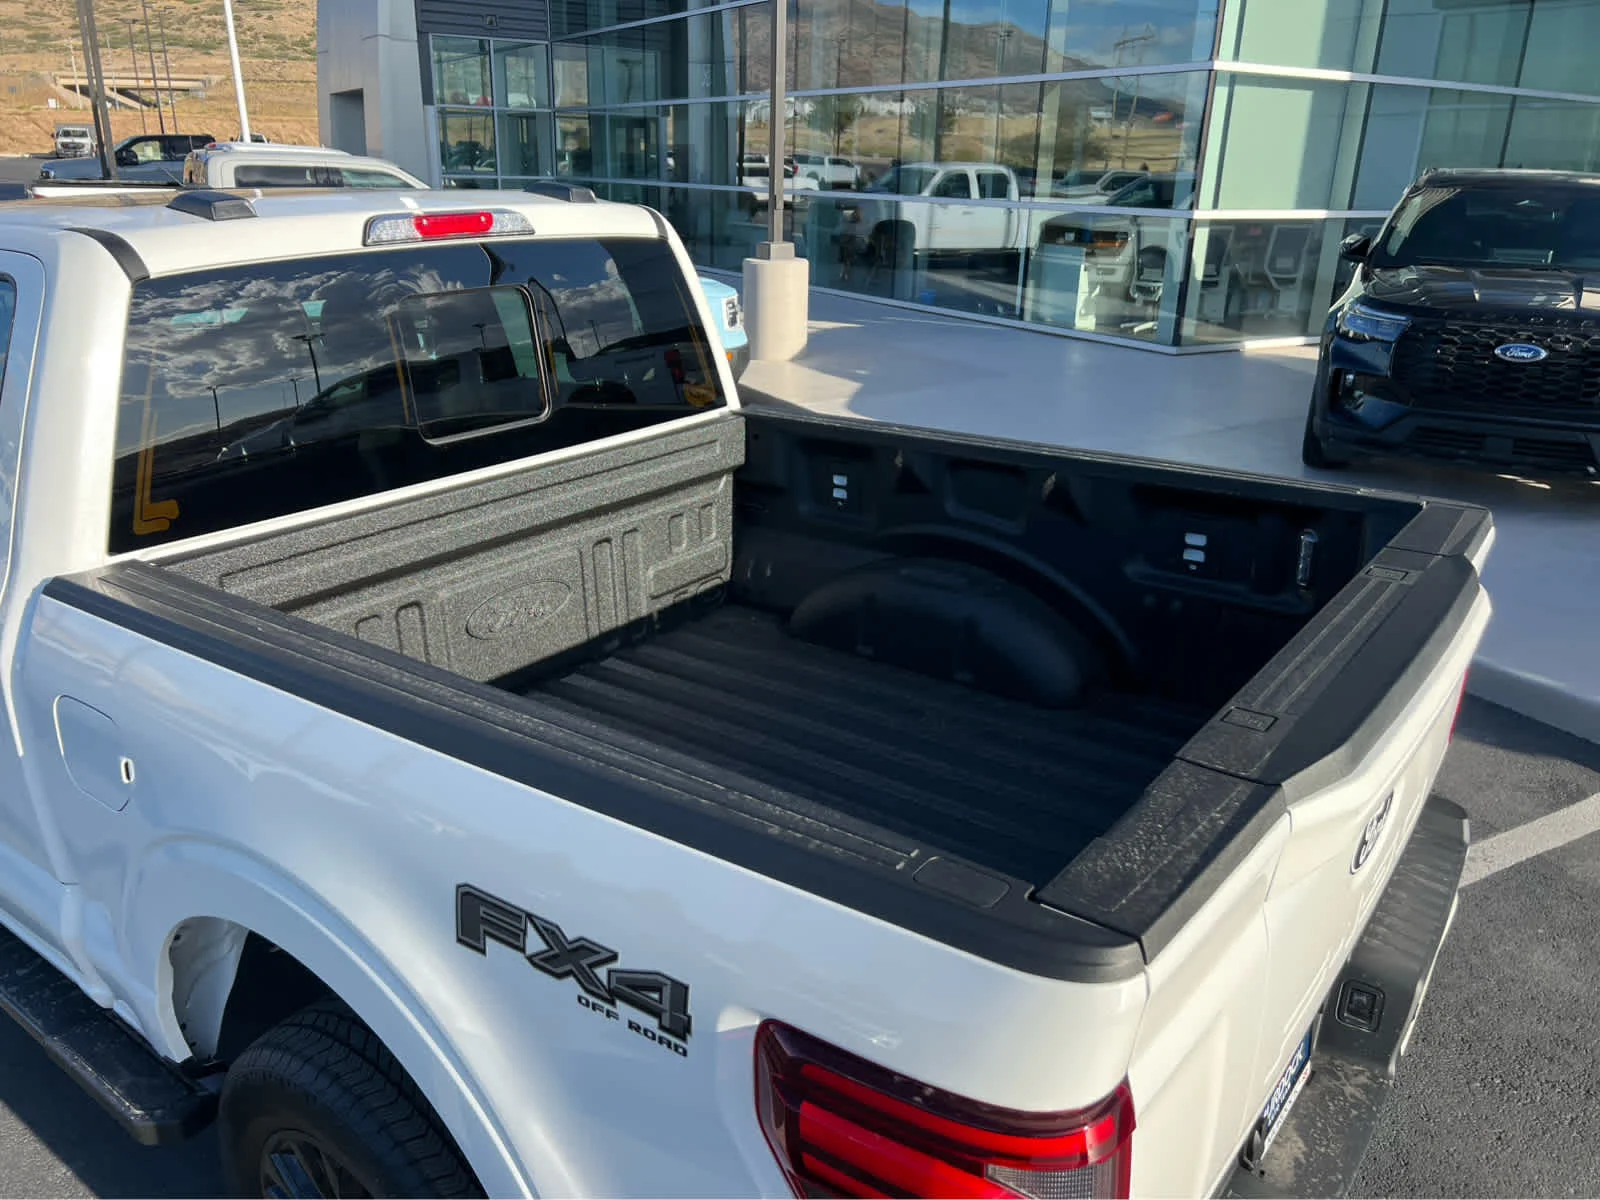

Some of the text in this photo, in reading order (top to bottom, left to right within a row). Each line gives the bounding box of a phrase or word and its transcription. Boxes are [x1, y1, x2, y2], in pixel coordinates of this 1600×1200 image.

[456, 883, 692, 1043] FX4
[577, 994, 688, 1057] OFF ROAD
